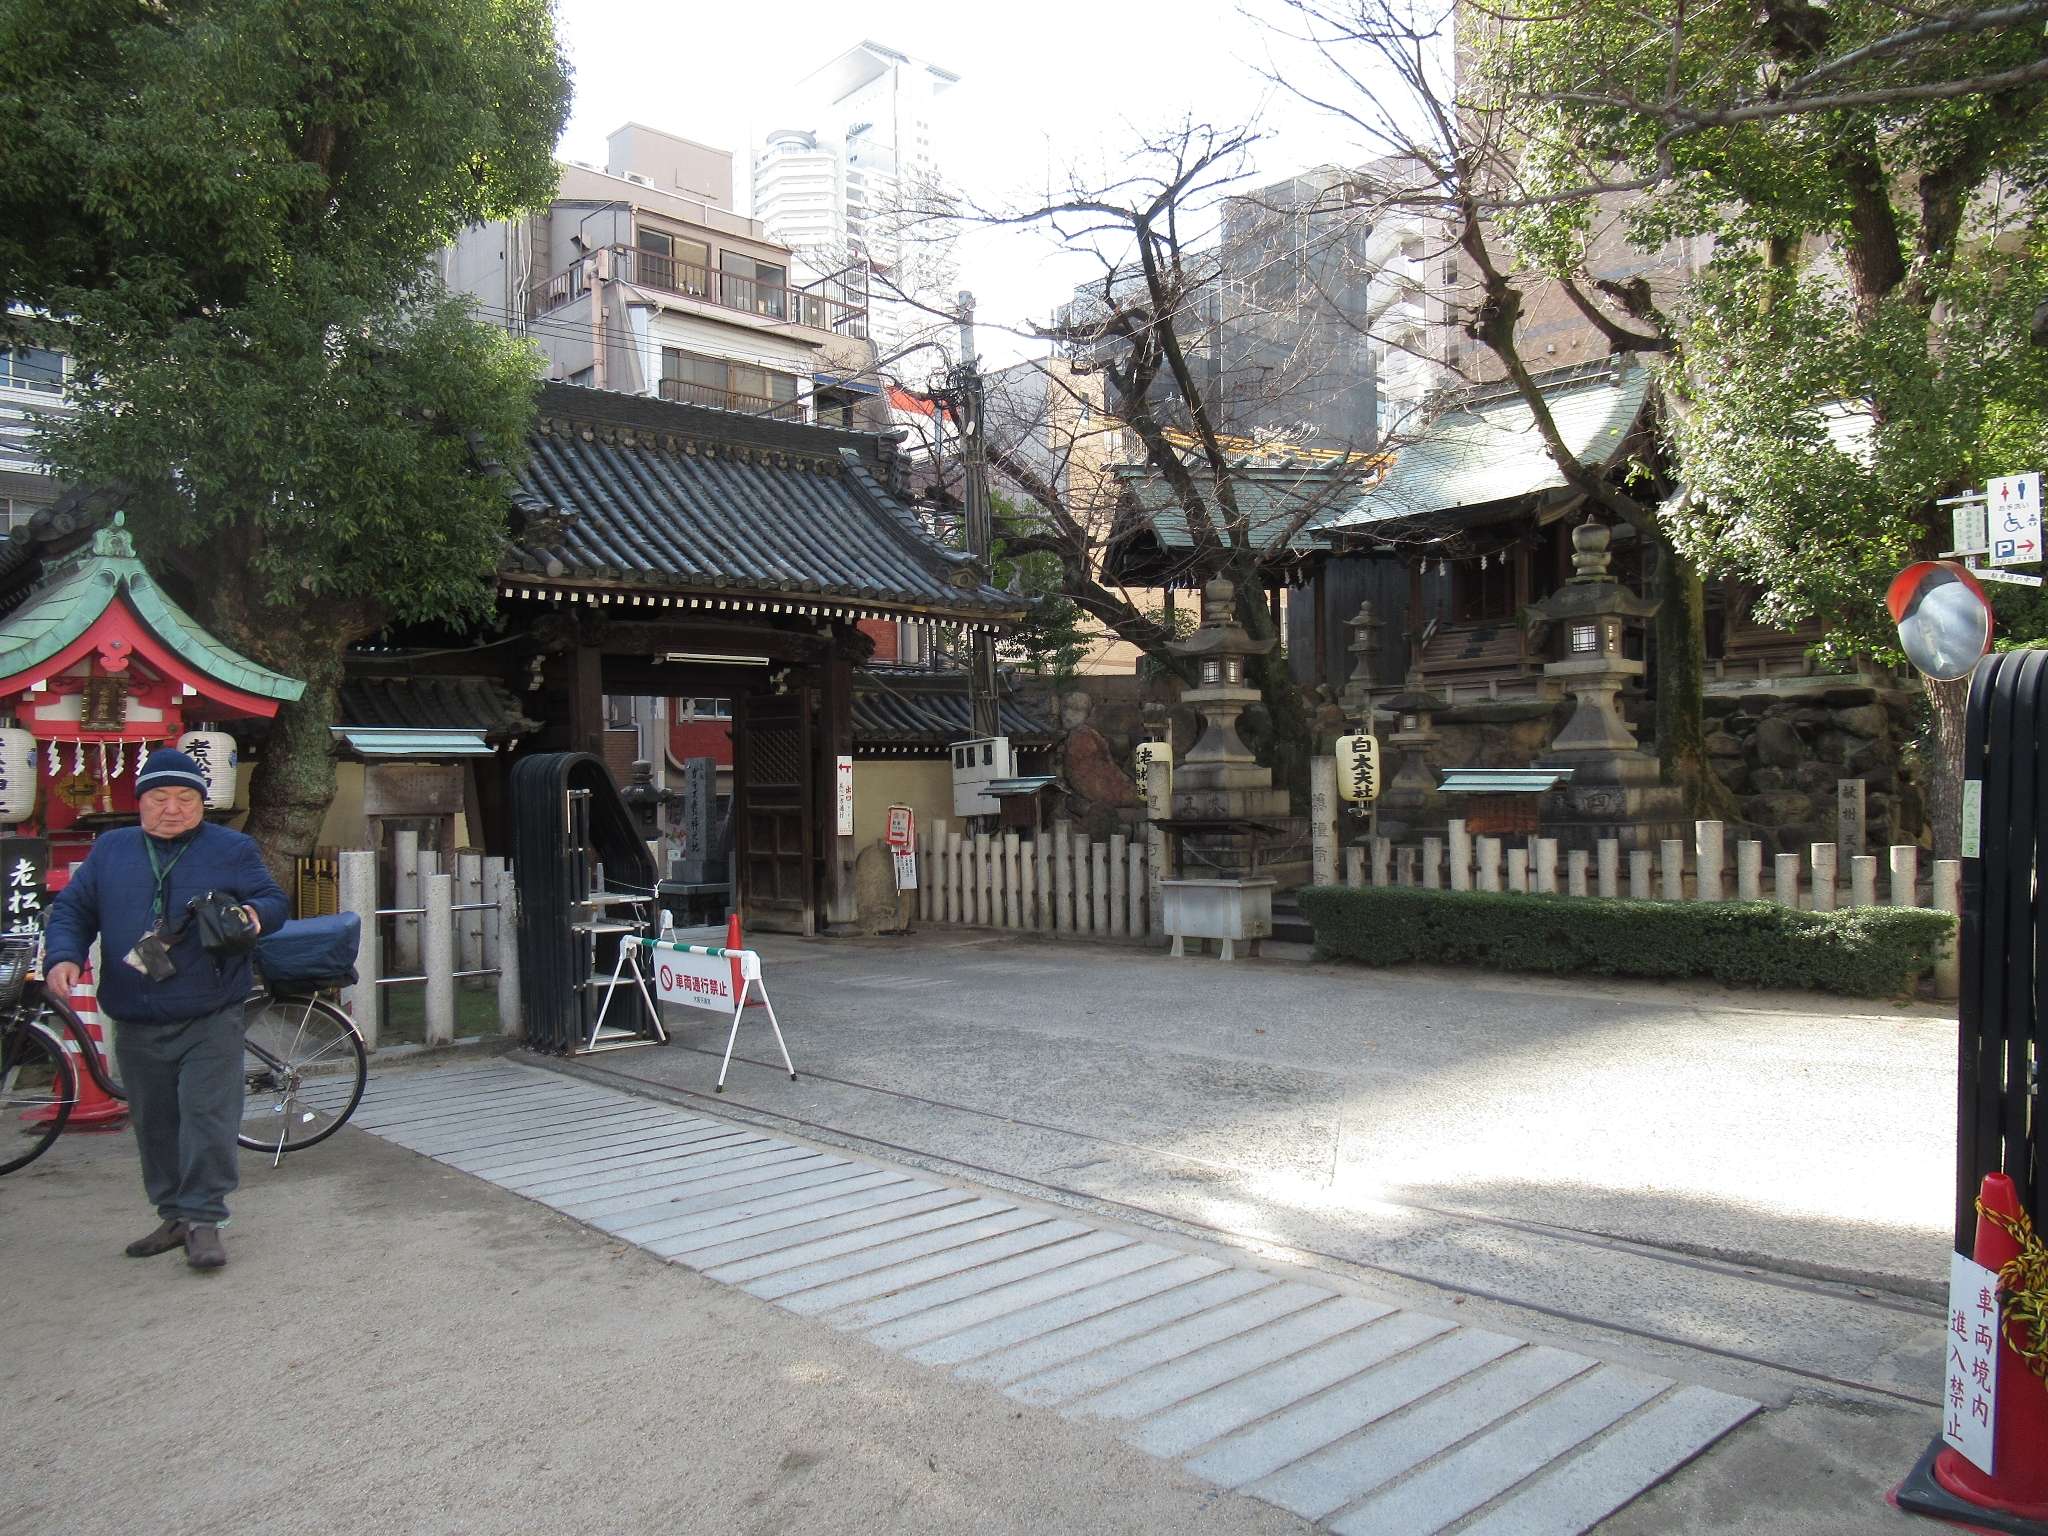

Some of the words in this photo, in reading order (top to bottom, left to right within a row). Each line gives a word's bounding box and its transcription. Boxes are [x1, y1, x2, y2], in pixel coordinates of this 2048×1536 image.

[1350, 736, 1374, 798] 白太夫社
[675, 973, 729, 997] 車両通行禁止
[1947, 1308, 1968, 1443] 進入禁止
[1972, 1286, 1994, 1428] 車両境内
